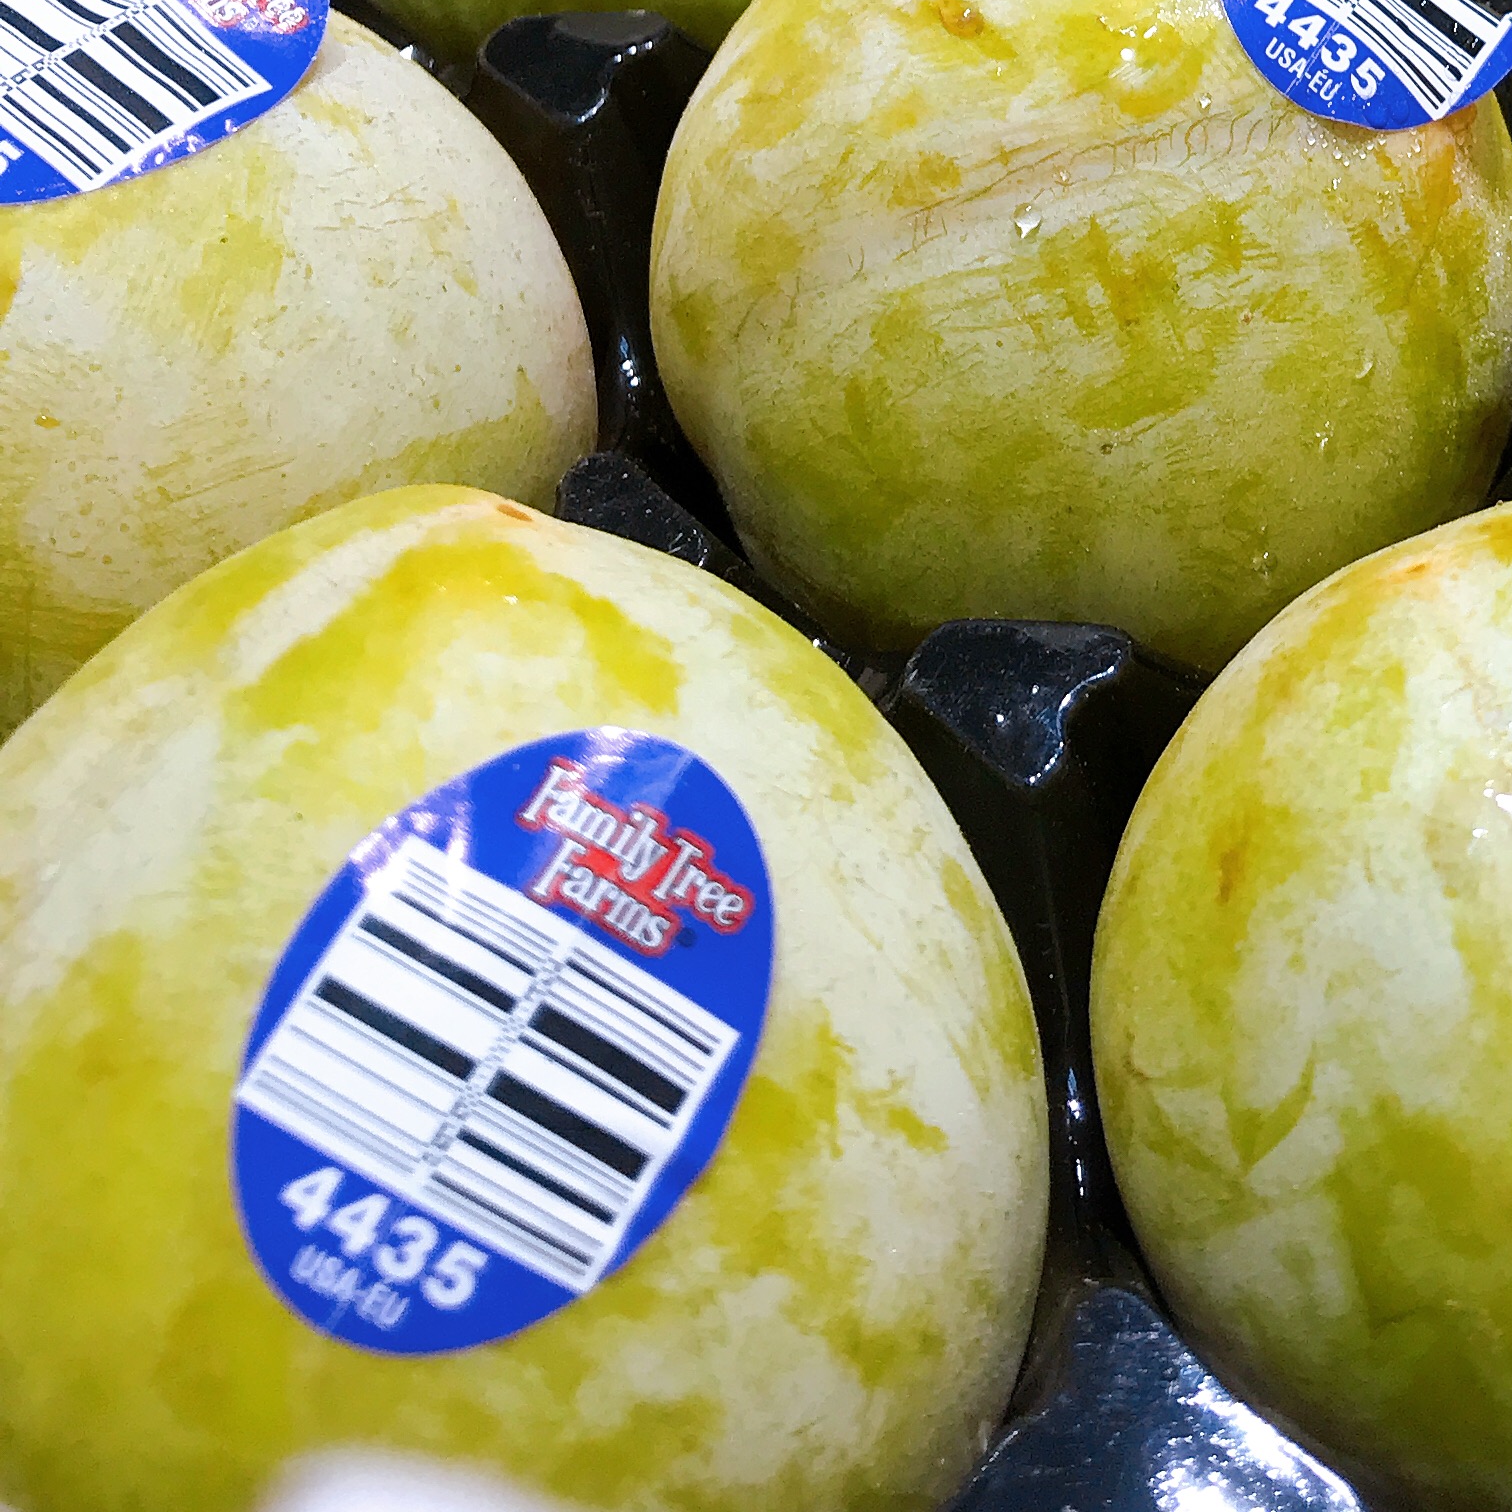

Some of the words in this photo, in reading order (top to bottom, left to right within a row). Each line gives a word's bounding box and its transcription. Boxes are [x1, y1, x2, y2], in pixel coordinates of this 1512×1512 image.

[521, 763, 669, 881] Family
[651, 836, 745, 926] Tree
[532, 837, 671, 948] Farms
[278, 1166, 490, 1311] 4435
